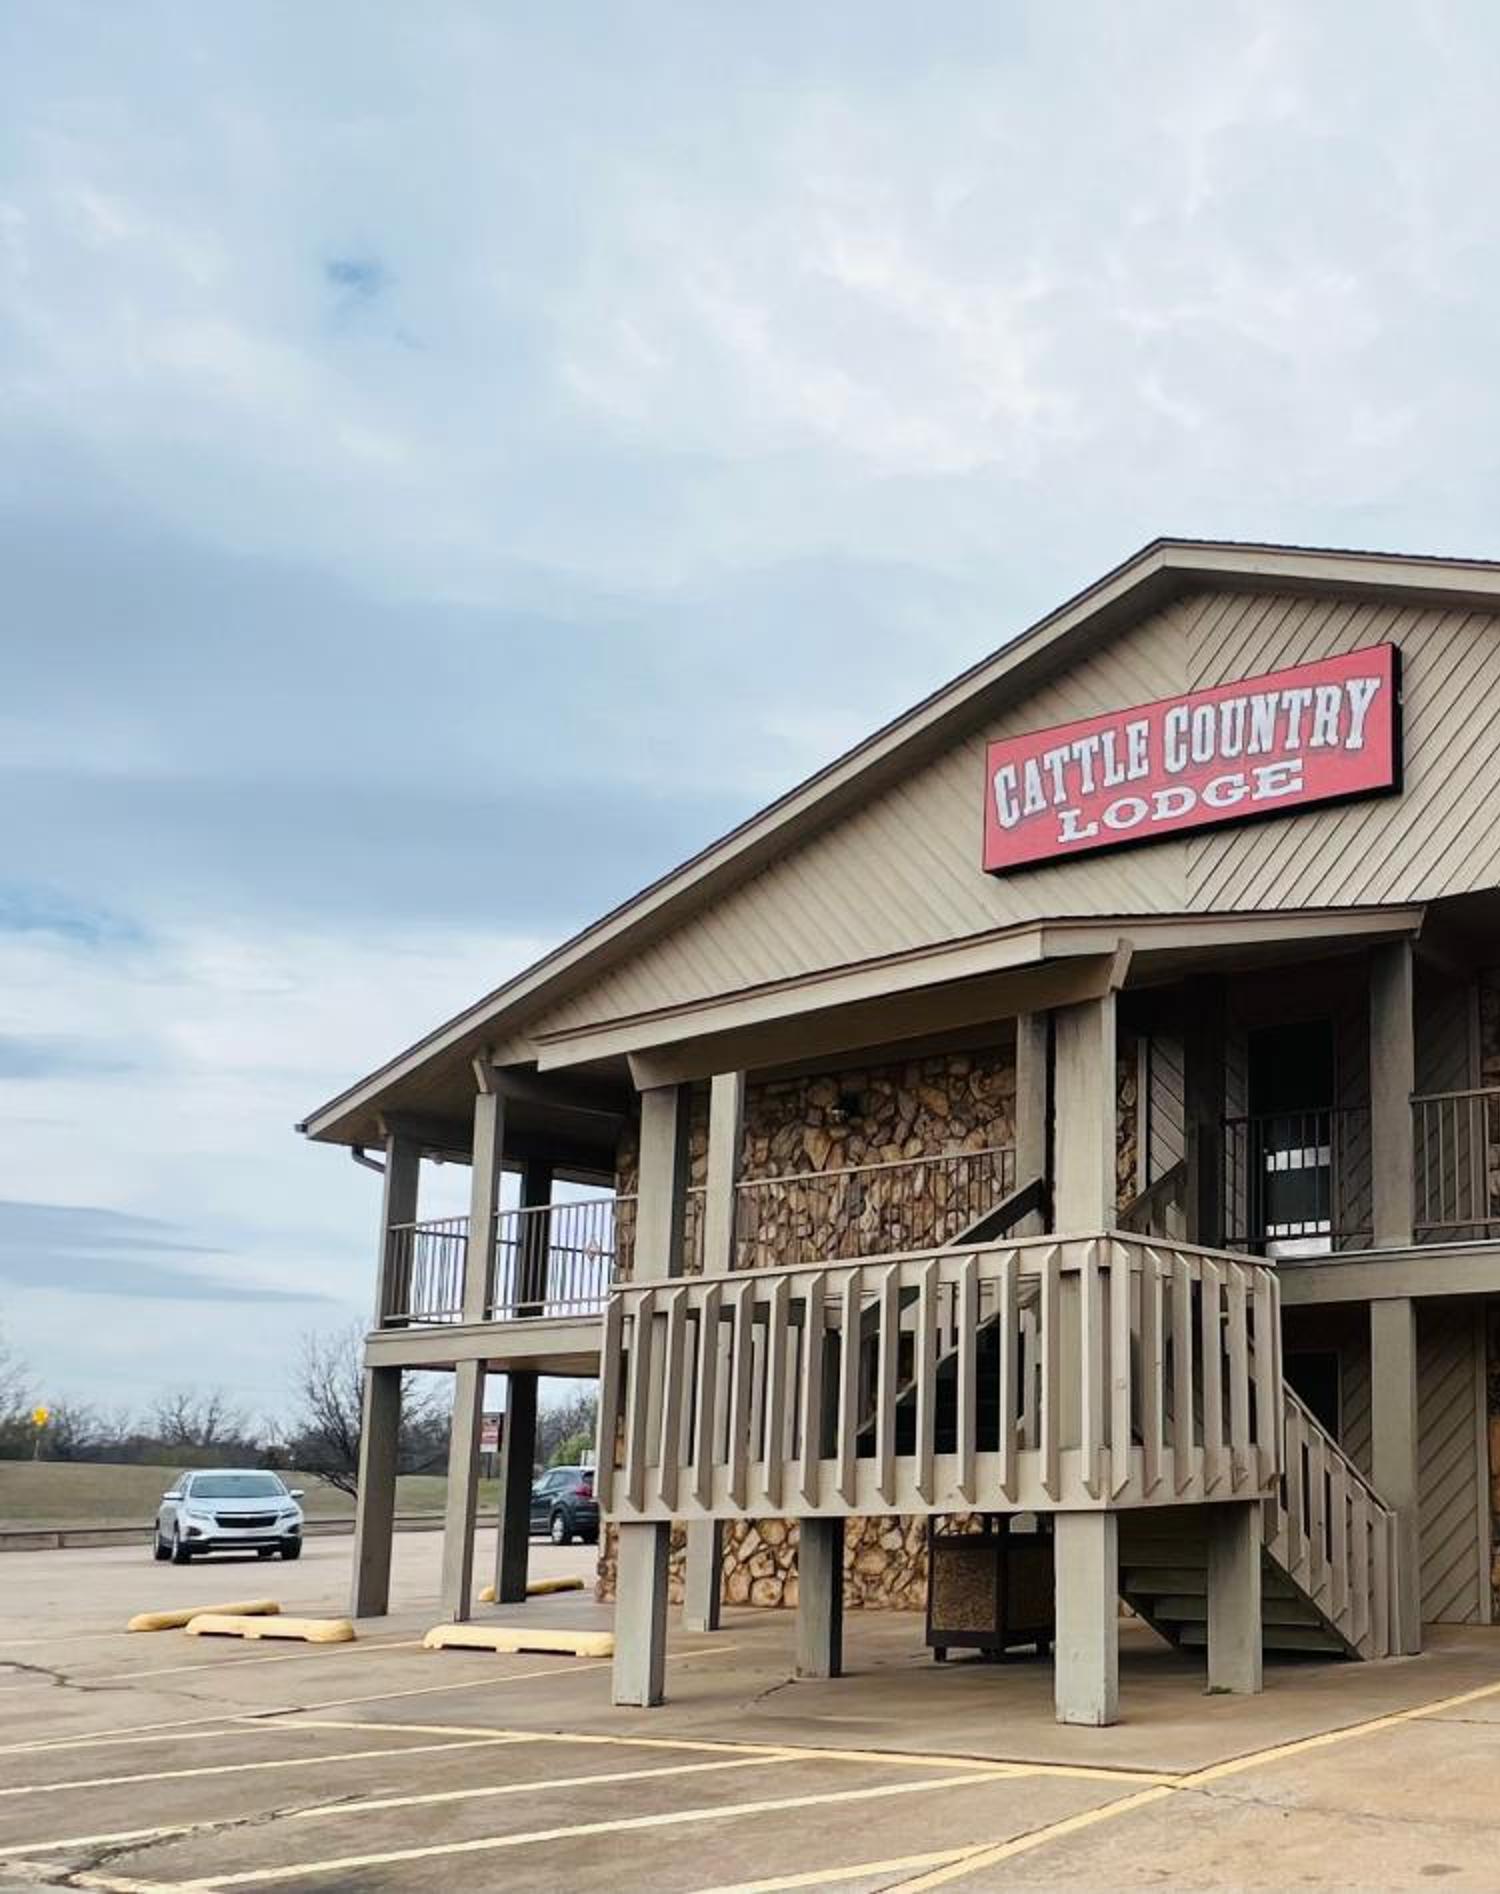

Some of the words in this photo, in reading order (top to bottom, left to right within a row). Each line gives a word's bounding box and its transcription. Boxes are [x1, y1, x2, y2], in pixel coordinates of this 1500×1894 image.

[993, 720, 1150, 829] CATTLE
[1163, 677, 1380, 774] COUNTRY
[1056, 758, 1304, 843] LODGE
